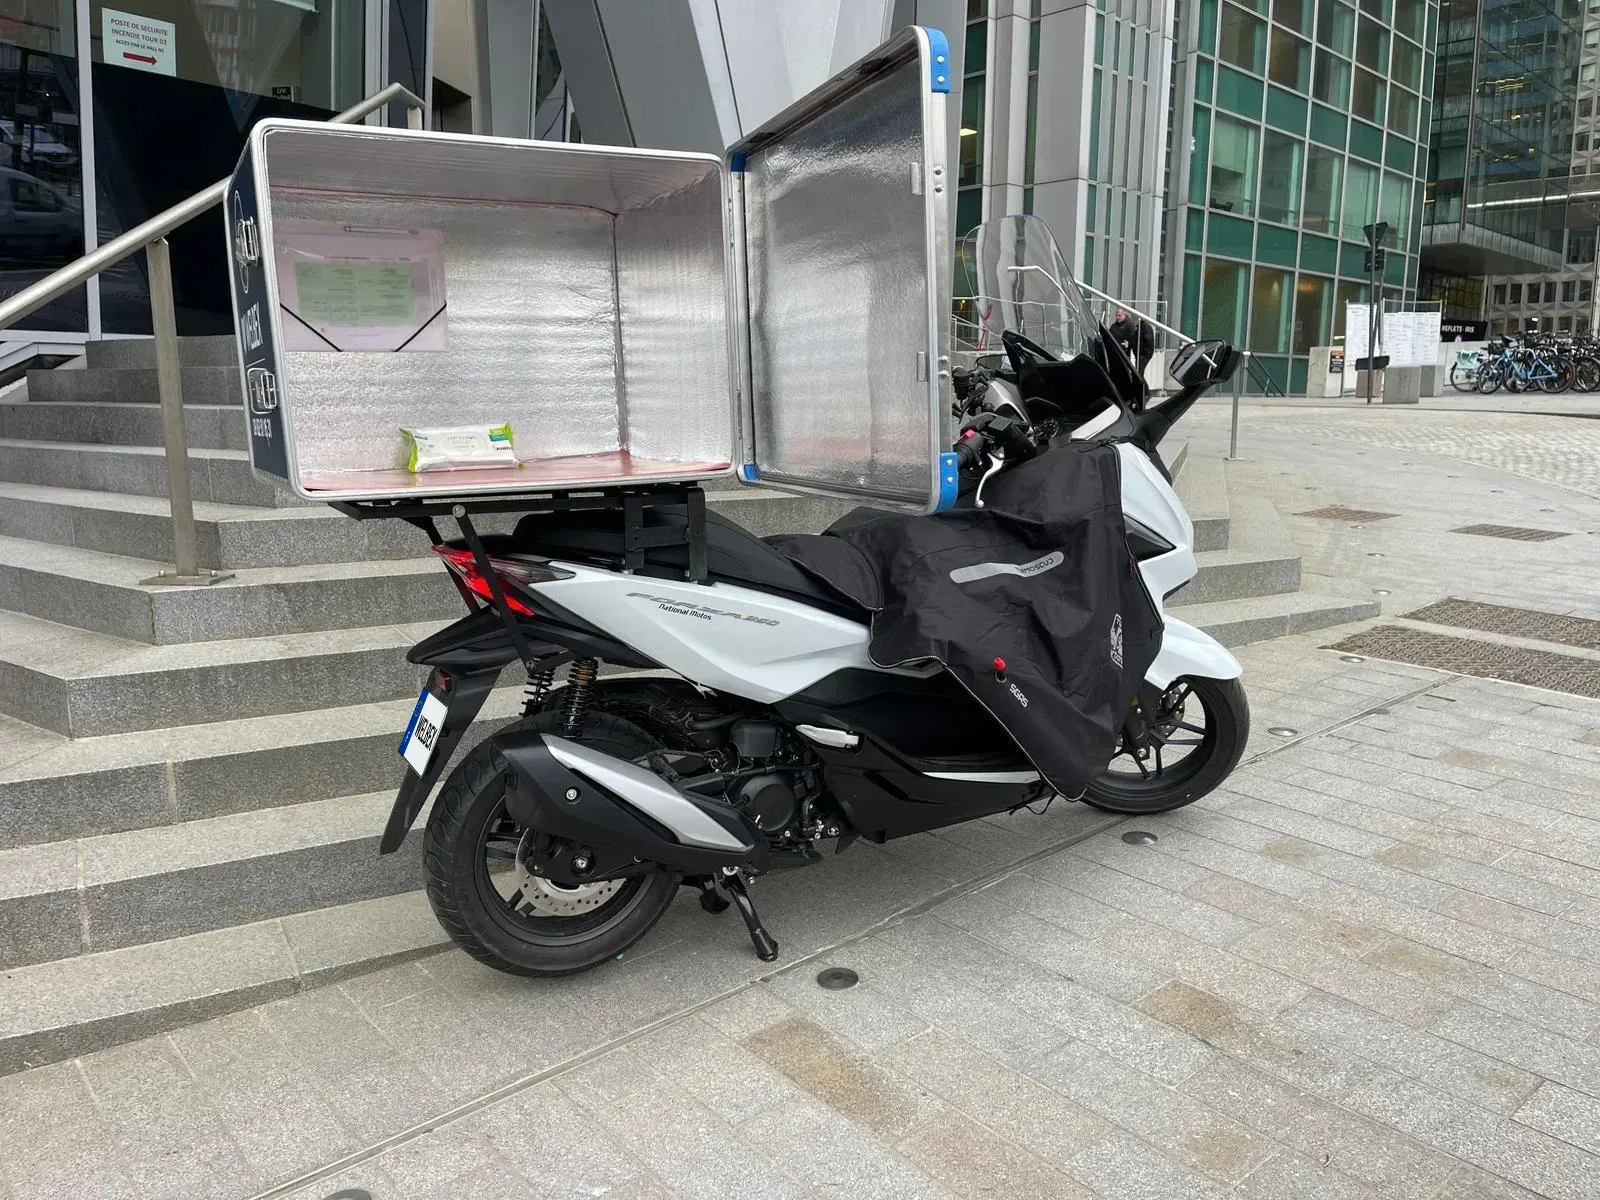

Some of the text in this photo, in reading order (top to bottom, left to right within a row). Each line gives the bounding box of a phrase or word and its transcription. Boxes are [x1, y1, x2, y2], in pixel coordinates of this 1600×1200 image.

[110, 18, 168, 36] POSTE DE SECURITE
[111, 28, 140, 39] INCENDIE
[141, 34, 158, 43] TOUR
[414, 714, 438, 752] WELBEX
